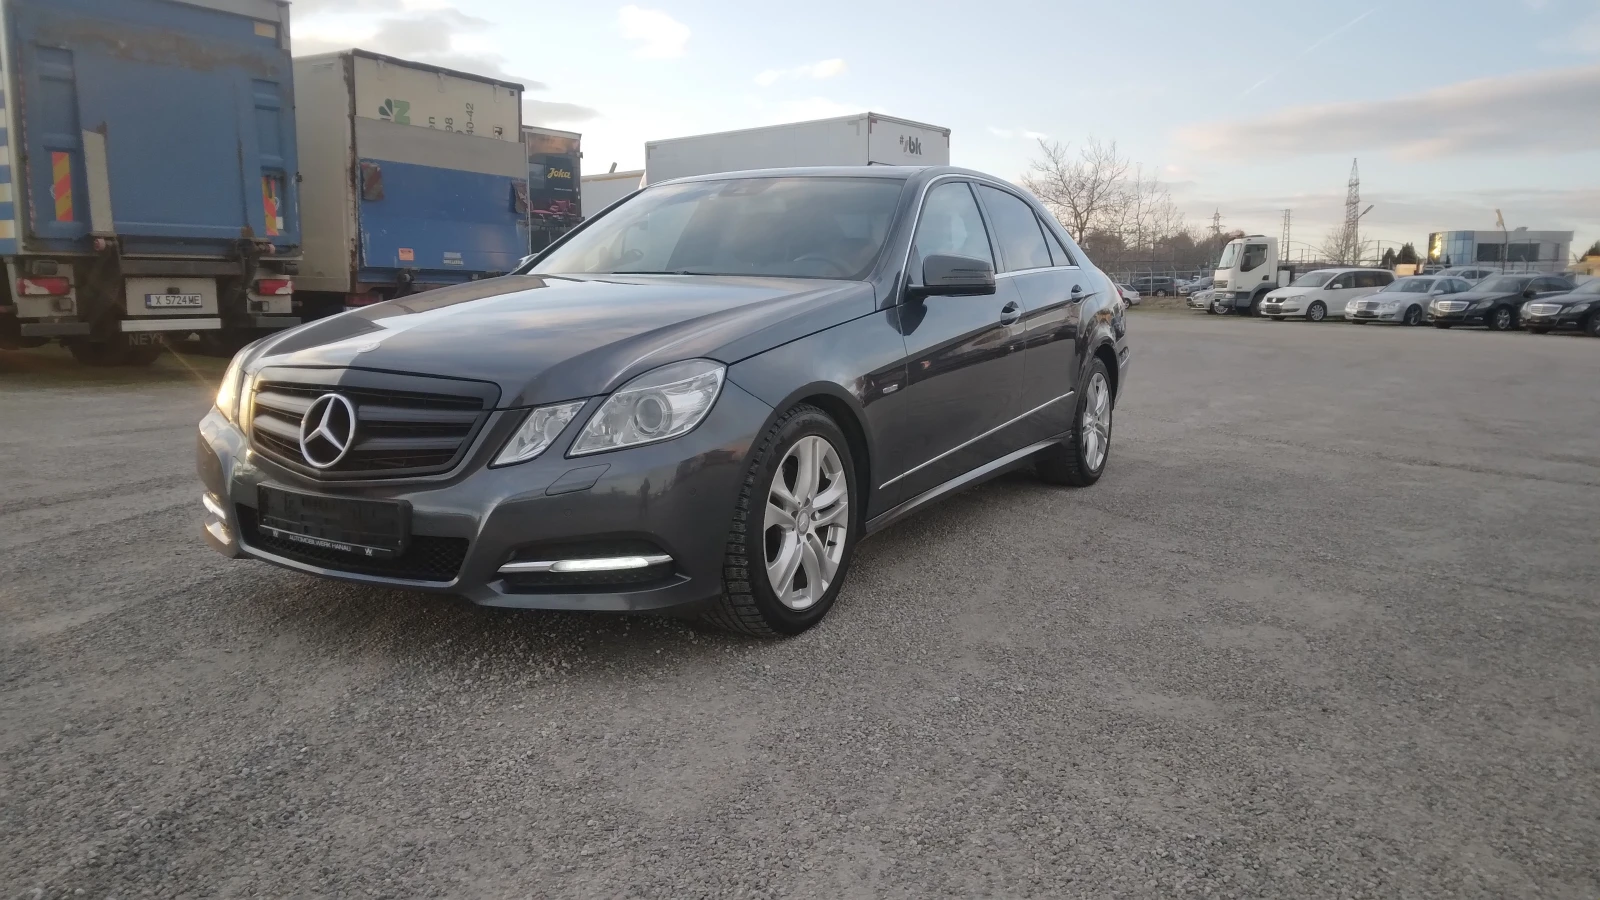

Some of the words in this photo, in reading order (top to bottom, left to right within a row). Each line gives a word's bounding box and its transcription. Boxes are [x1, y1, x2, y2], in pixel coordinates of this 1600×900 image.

[547, 167, 571, 179] Joka
[155, 296, 162, 305] X
[332, 543, 351, 552] HANAU
